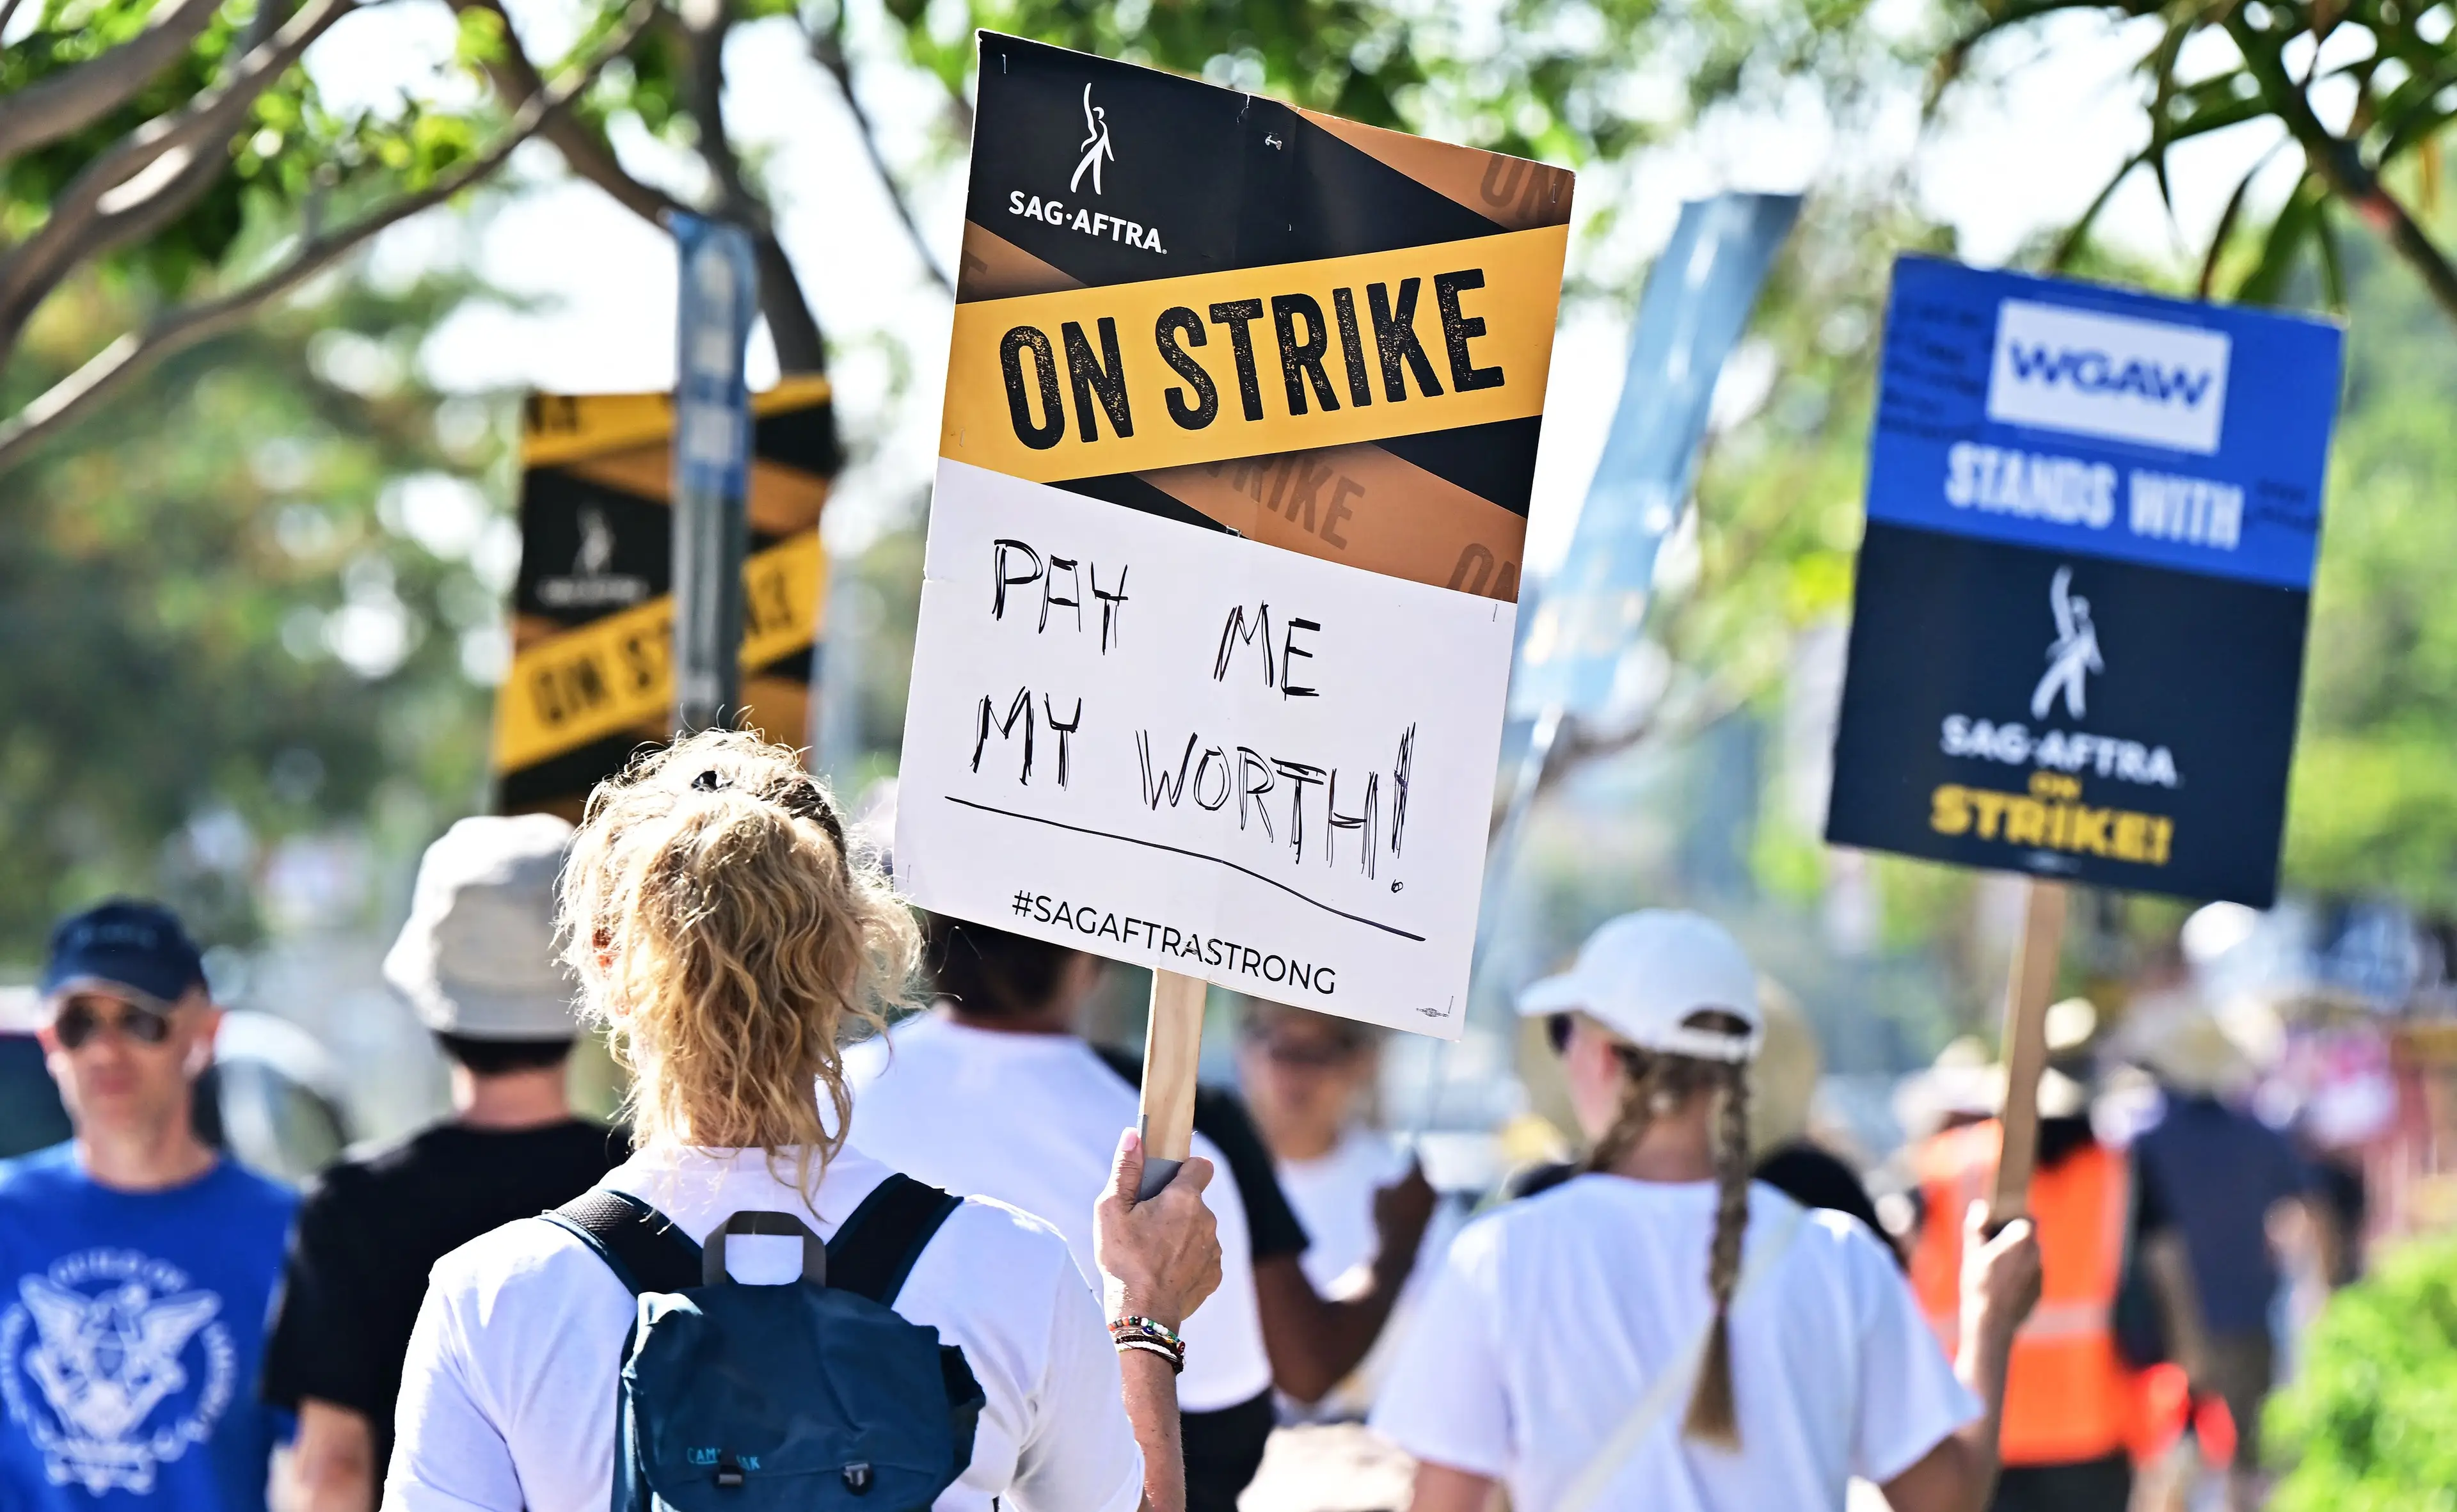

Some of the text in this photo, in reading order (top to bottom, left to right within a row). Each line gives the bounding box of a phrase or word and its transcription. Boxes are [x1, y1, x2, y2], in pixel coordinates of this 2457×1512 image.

[999, 267, 1505, 450] ON STRIKE
[2007, 338, 2211, 408] WGAW
[1944, 440, 2247, 552] STANDS WITH
[991, 538, 1322, 701] PAY ME
[969, 686, 1416, 894] MY WORTH!
[1928, 783, 2174, 868] STRIKE!
[2028, 770, 2083, 802] ON
[1012, 889, 1336, 995] #SAGAFTRASTRONG
